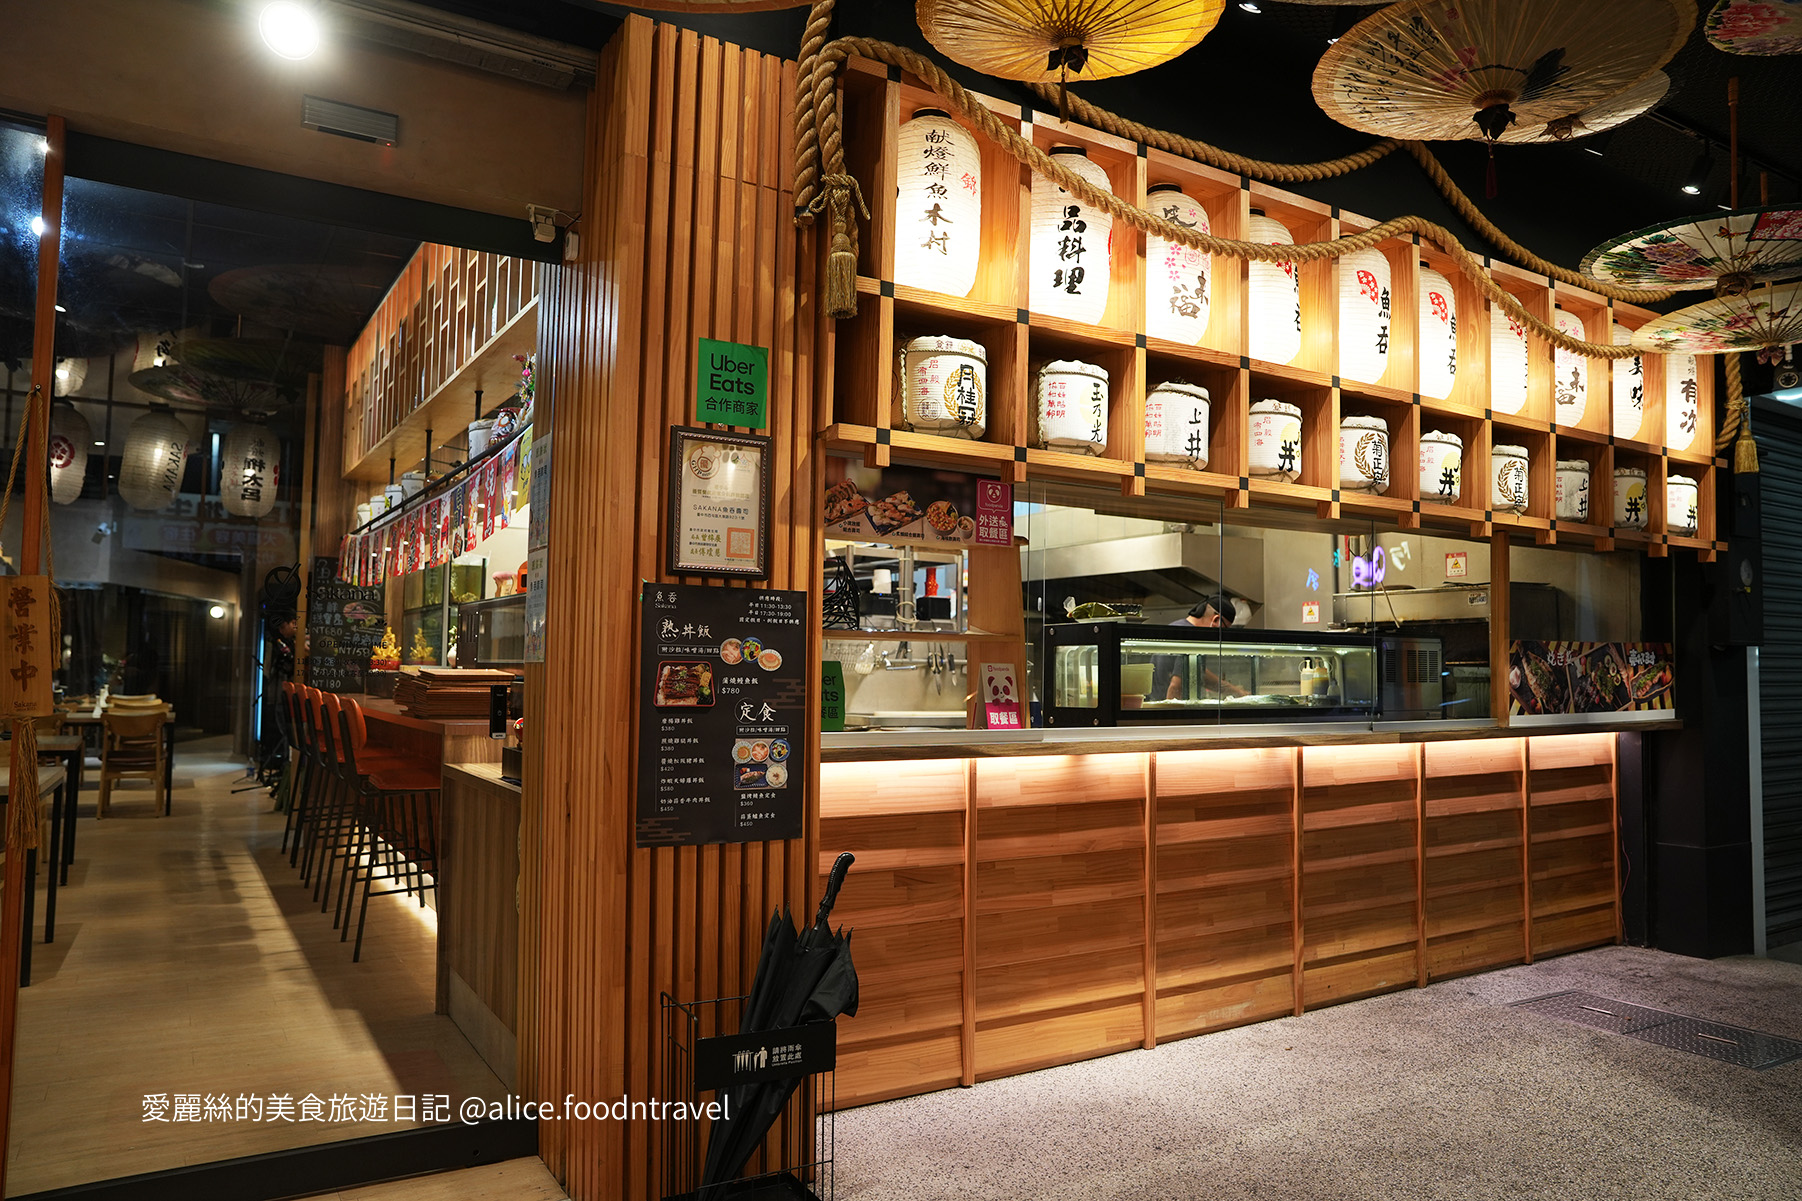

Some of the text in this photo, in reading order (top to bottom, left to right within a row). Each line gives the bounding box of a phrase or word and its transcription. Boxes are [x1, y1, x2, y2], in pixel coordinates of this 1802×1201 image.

[1052, 186, 1087, 295] 品料理
[711, 353, 755, 375] Uber
[710, 373, 755, 395] Eats
[705, 396, 758, 415] 合作商家
[1091, 382, 1104, 442] 玉乃光
[979, 514, 998, 526] 外送
[979, 527, 1008, 539] 取餐區
[8, 586, 38, 692] 營業中
[740, 702, 776, 721] 定食
[990, 712, 1018, 725] 取餐區
